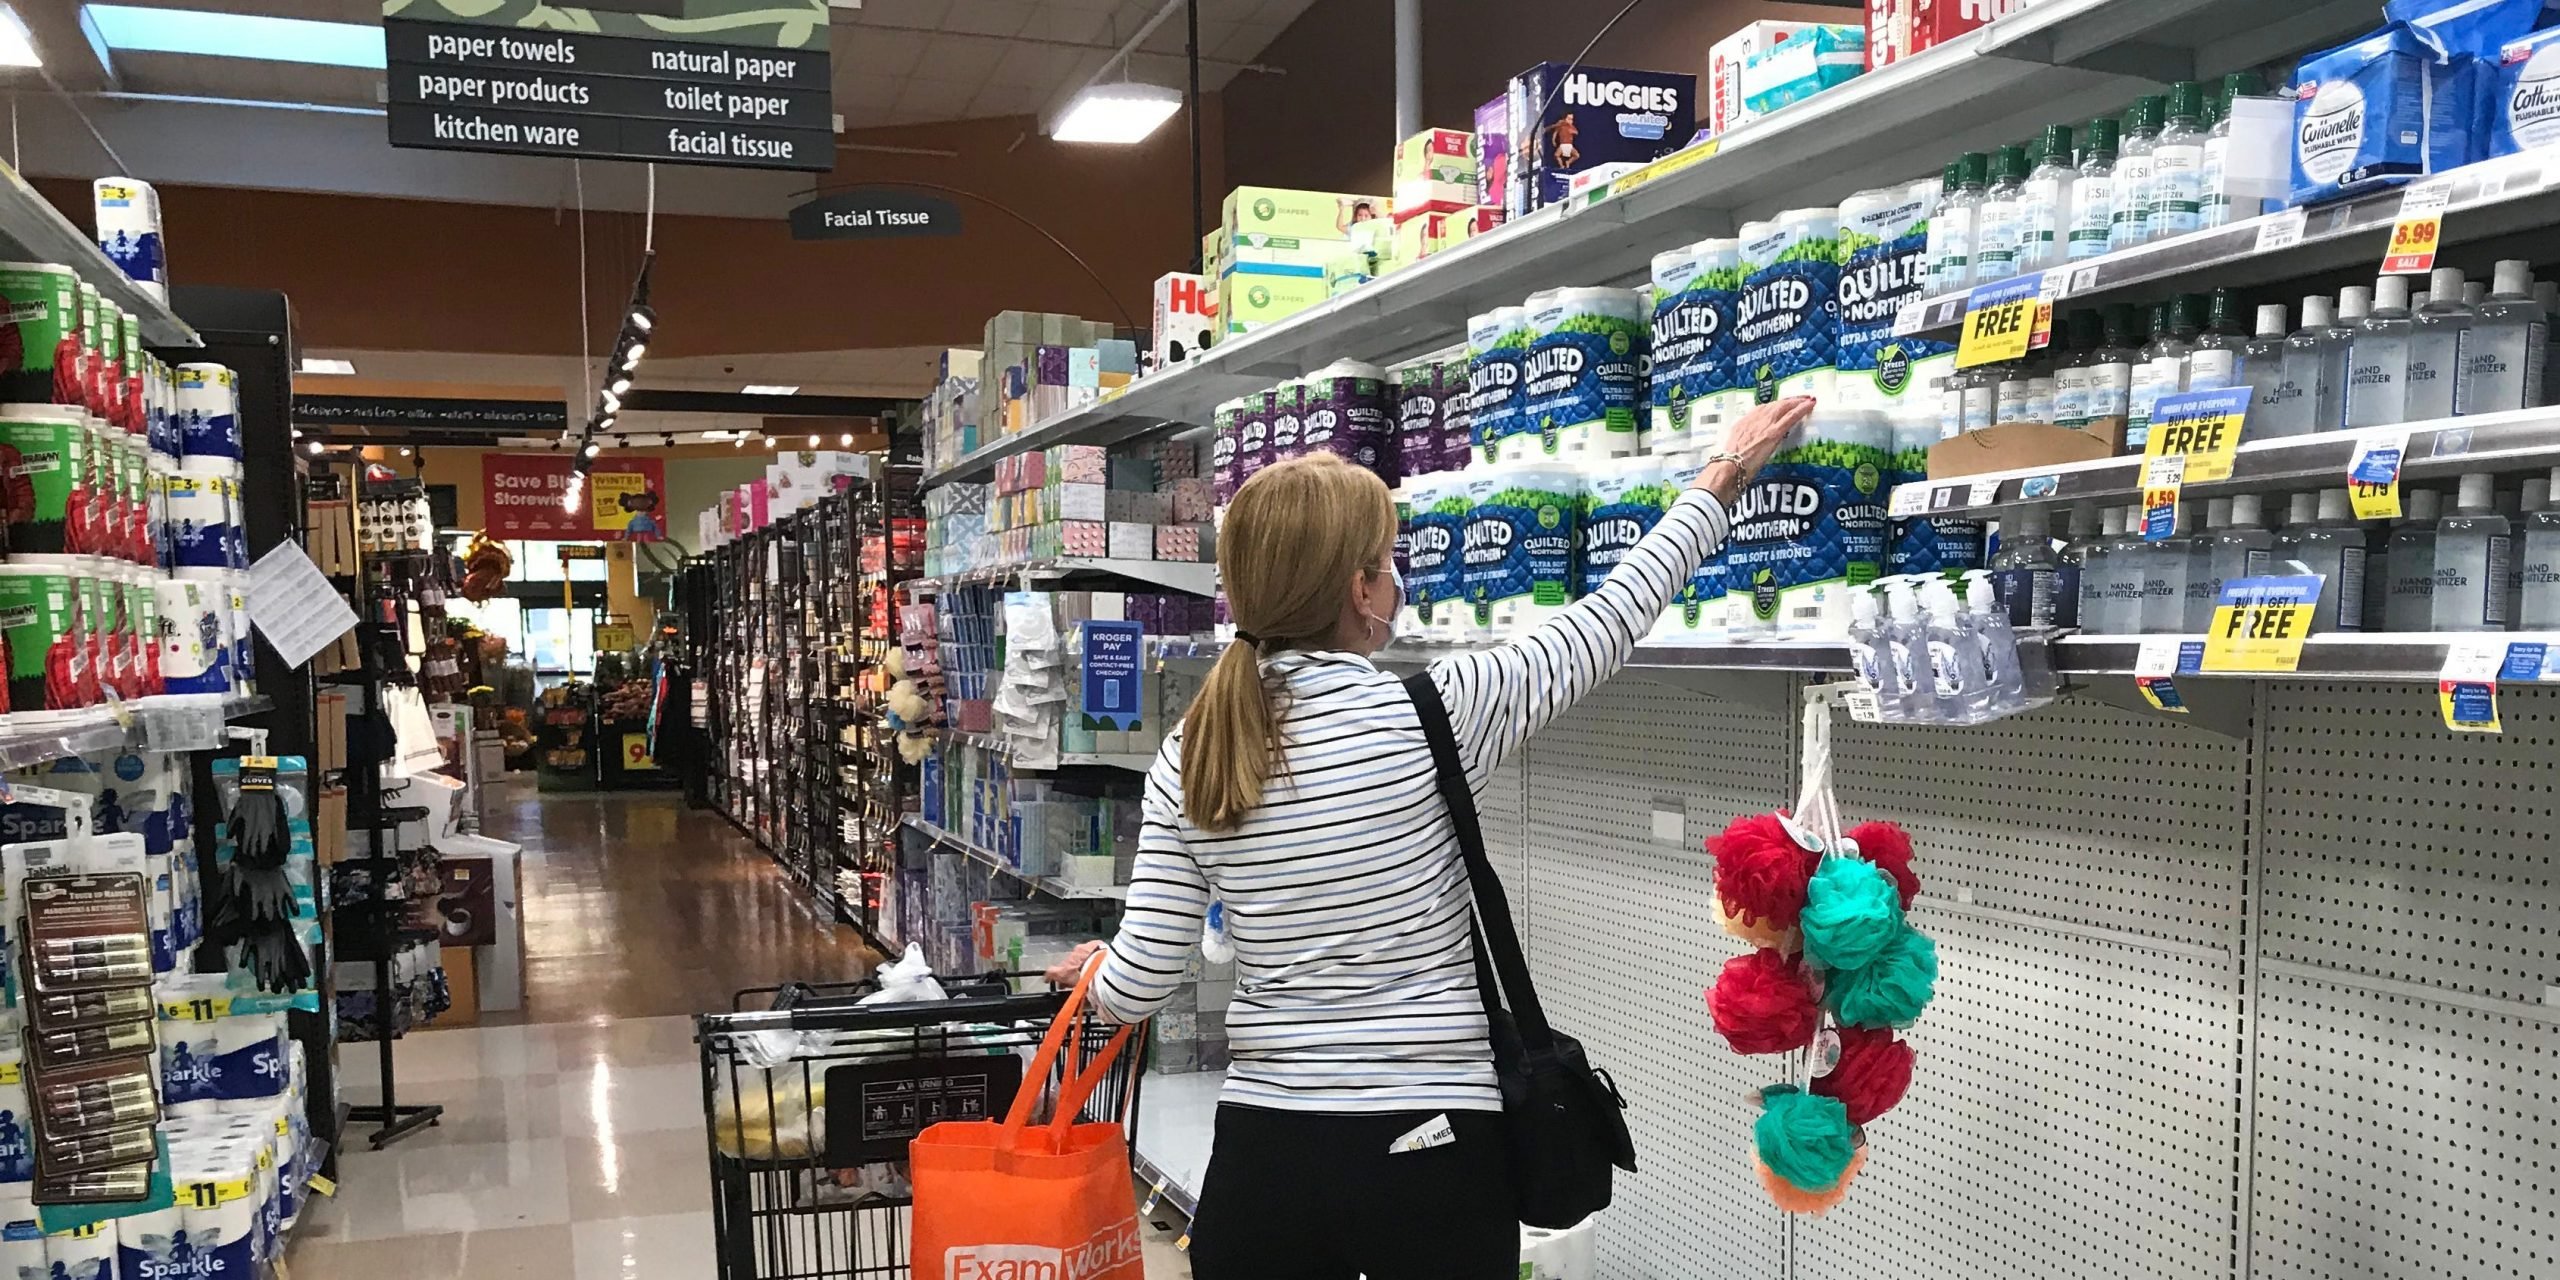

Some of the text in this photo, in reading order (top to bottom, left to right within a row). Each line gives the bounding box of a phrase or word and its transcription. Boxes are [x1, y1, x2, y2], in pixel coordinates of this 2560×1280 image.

[428, 34, 576, 63] paper towels
[652, 49, 796, 82] natural paper
[419, 75, 589, 104] paper products
[1564, 73, 1678, 112] HUGGIES
[664, 86, 790, 118] toilet paper
[2516, 106, 2554, 122] FLUSHABLE
[433, 113, 580, 147] kitchen ware
[668, 129, 793, 159] facial tissue
[2305, 133, 2357, 154] FLUSHABLE WIPES
[118, 187, 126, 199] 3
[824, 209, 929, 227] Facial Tissue
[1862, 210, 1896, 225] PREMIUM
[2398, 257, 2419, 267] SALE
[1737, 280, 1809, 328] QUILTED
[1741, 312, 1794, 343] NORTHERN
[1974, 305, 2024, 339] FREE
[1655, 337, 1705, 364] NORTHERN
[1773, 339, 1803, 355] STRONG
[1524, 348, 1583, 384] QUILTED
[193, 371, 200, 382] 3
[1528, 374, 1572, 396] NORTHERN
[2056, 379, 2071, 390] CSI
[2168, 414, 2188, 427] BUY
[2199, 411, 2219, 423] GET
[2161, 423, 2225, 455] FREE
[184, 479, 192, 489] 3
[212, 481, 218, 490] 2
[494, 473, 541, 488] Save
[594, 475, 642, 485] WINTER
[1729, 483, 1819, 526] QUILTED
[2146, 490, 2175, 508] 4.59
[1836, 505, 1888, 521] QUILTED
[1736, 518, 1799, 541] NORTHERN
[1524, 536, 1571, 550] QUILTED
[1843, 536, 1869, 544] ULTRA
[1749, 551, 1769, 562] SOFT
[2400, 577, 2432, 586] HAND
[234, 598, 240, 607] 2
[2105, 590, 2143, 599] SANITIZER
[2268, 597, 2289, 608] GET
[2293, 597, 2298, 608] 1
[2226, 610, 2295, 638] FREE
[1092, 633, 1132, 642] KROGER
[1103, 643, 1121, 651] PAY
[2, 813, 104, 840] Spare
[170, 1000, 214, 1021] 6 11
[163, 1063, 222, 1083] parkle
[1432, 1127, 1455, 1142] MED
[190, 1183, 216, 1206] 11
[954, 1228, 1142, 1280] Exam Works
[139, 1254, 225, 1280] Sparkle
